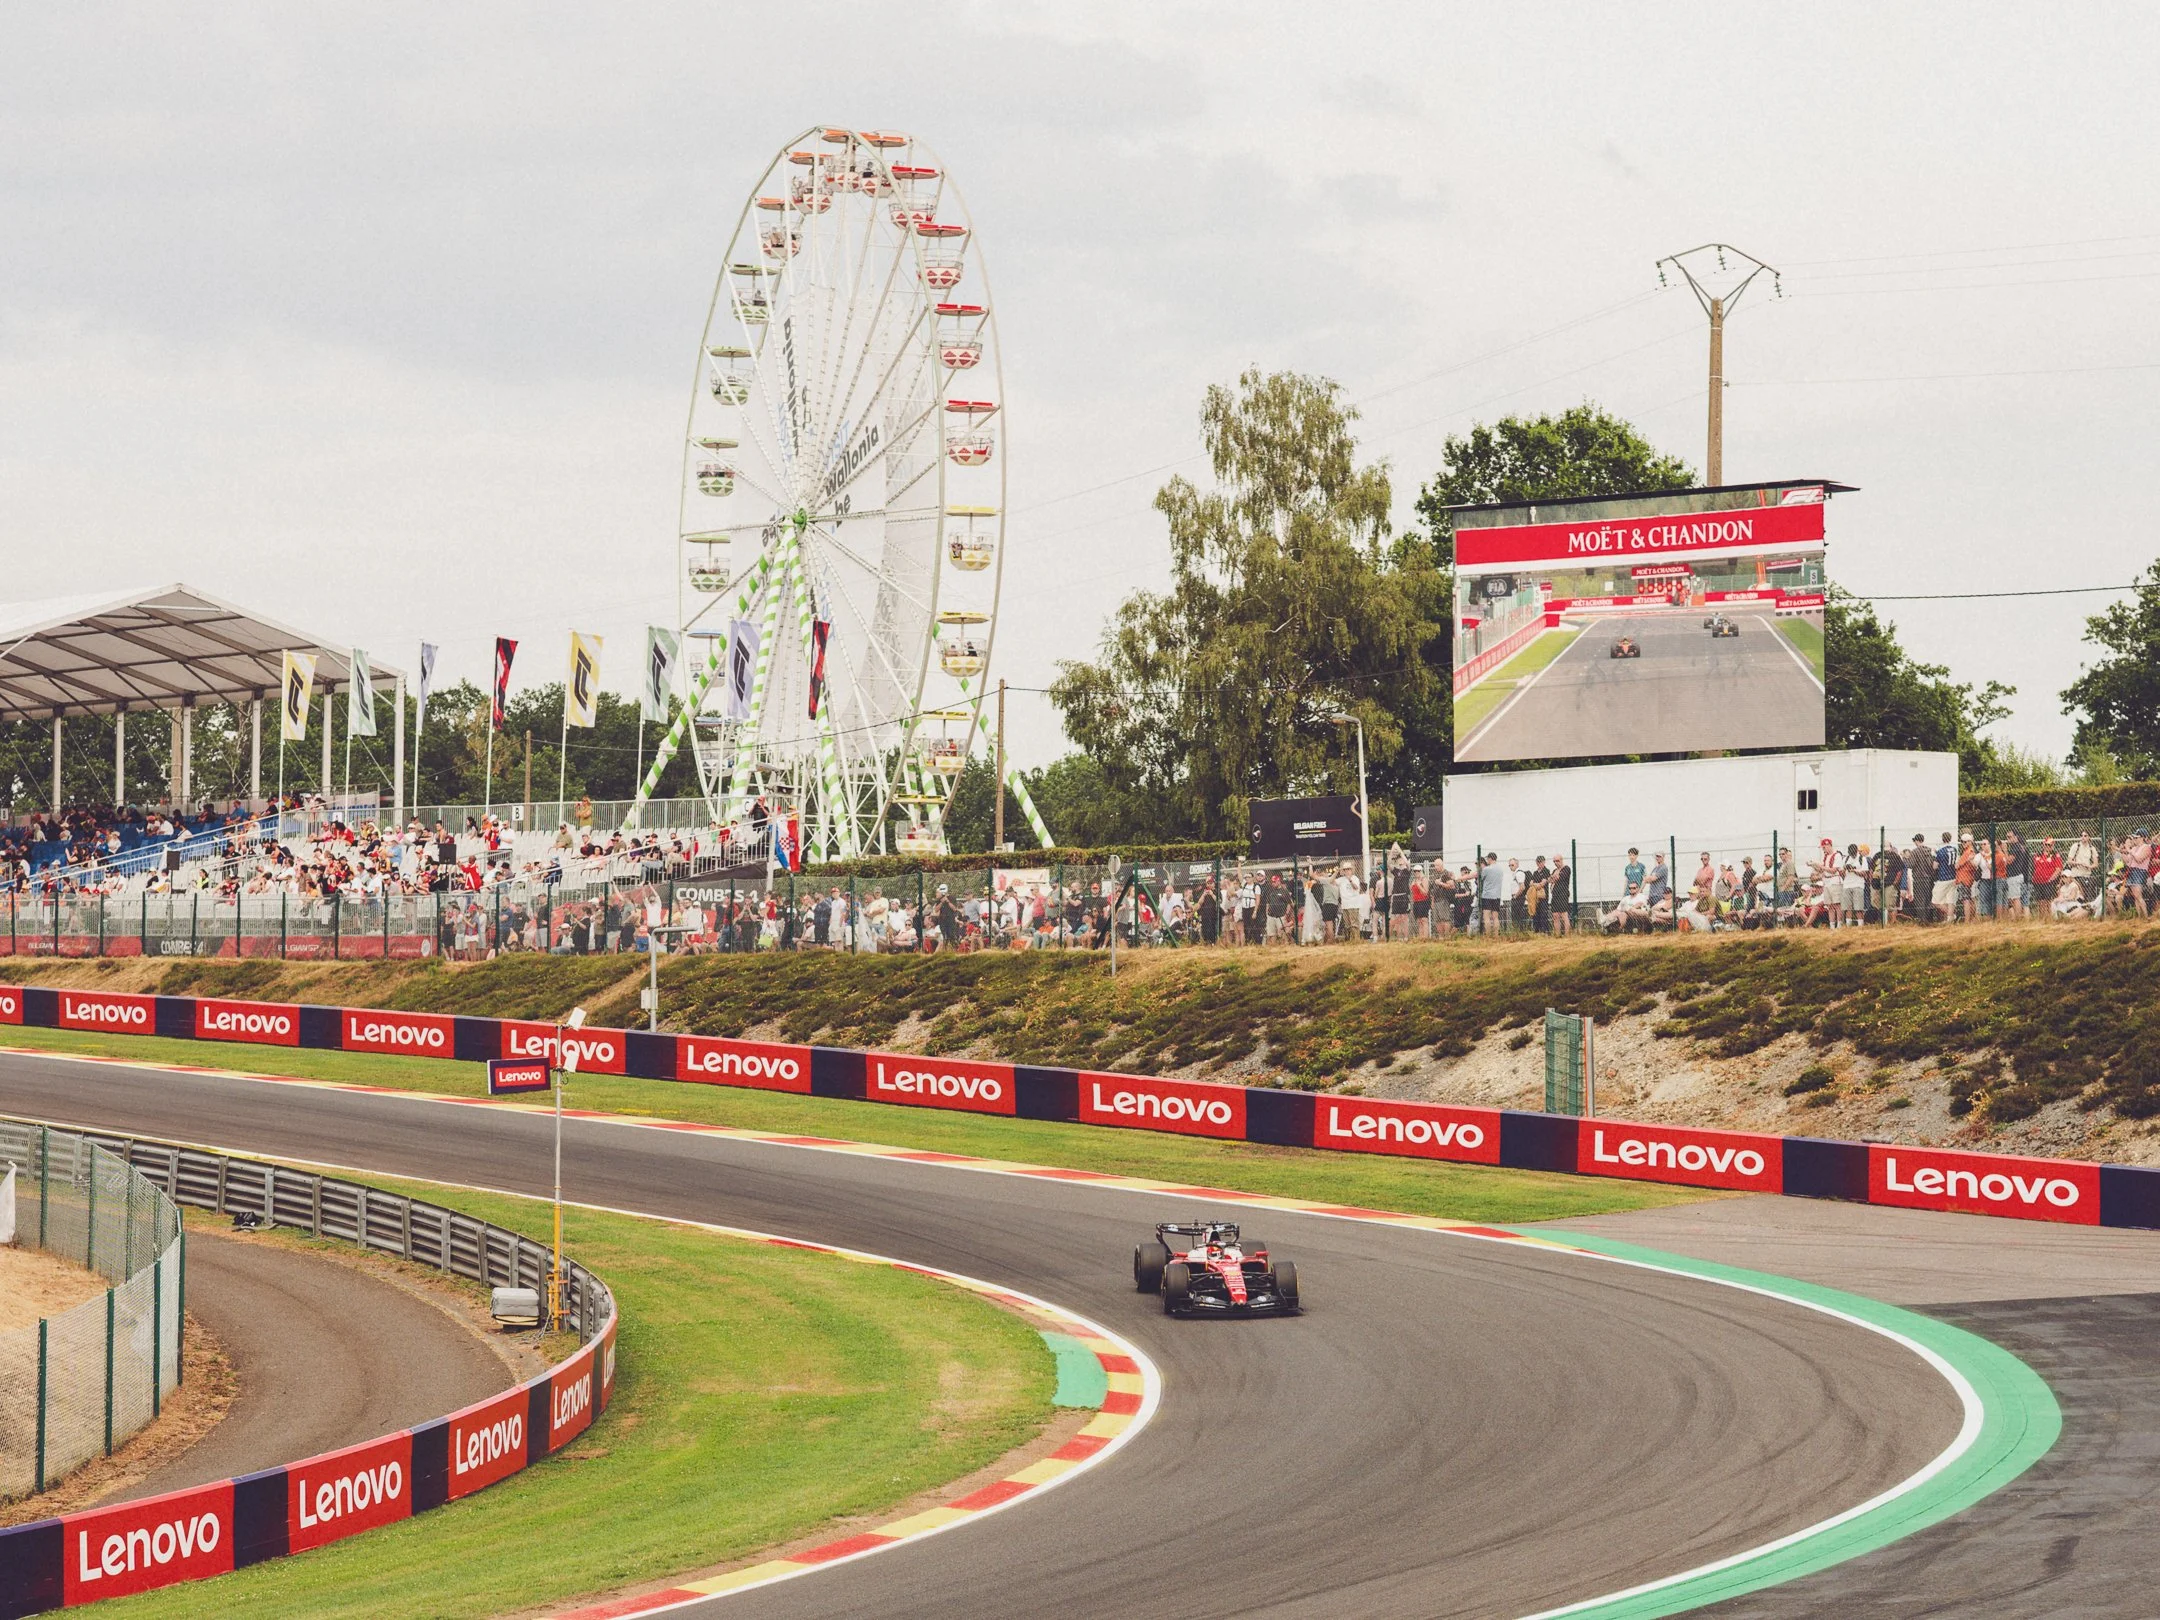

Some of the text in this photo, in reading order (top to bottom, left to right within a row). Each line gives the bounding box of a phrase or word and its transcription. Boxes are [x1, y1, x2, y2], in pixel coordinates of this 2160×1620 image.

[824, 424, 879, 497] wallonia
[1568, 519, 1753, 552] MOËT & CHANDON
[66, 997, 147, 1024] Lenovo
[204, 1007, 290, 1034] Lenovo
[351, 1017, 445, 1047] Lenovo
[510, 1029, 615, 1063] Lenovo
[498, 1071, 541, 1082] Lenovo
[687, 1045, 799, 1080] Lenovo
[878, 1063, 1002, 1101] Lenovo
[1093, 1083, 1232, 1124] Lenovo
[1330, 1106, 1484, 1149] Lenovo
[1594, 1130, 1765, 1176] Lenovo
[1886, 1157, 2079, 1207] Lenovo
[553, 1373, 590, 1430] Lenovo
[455, 1413, 522, 1475] Lenovo
[300, 1461, 402, 1529] Lenovo
[79, 1513, 220, 1582] Lenovo
